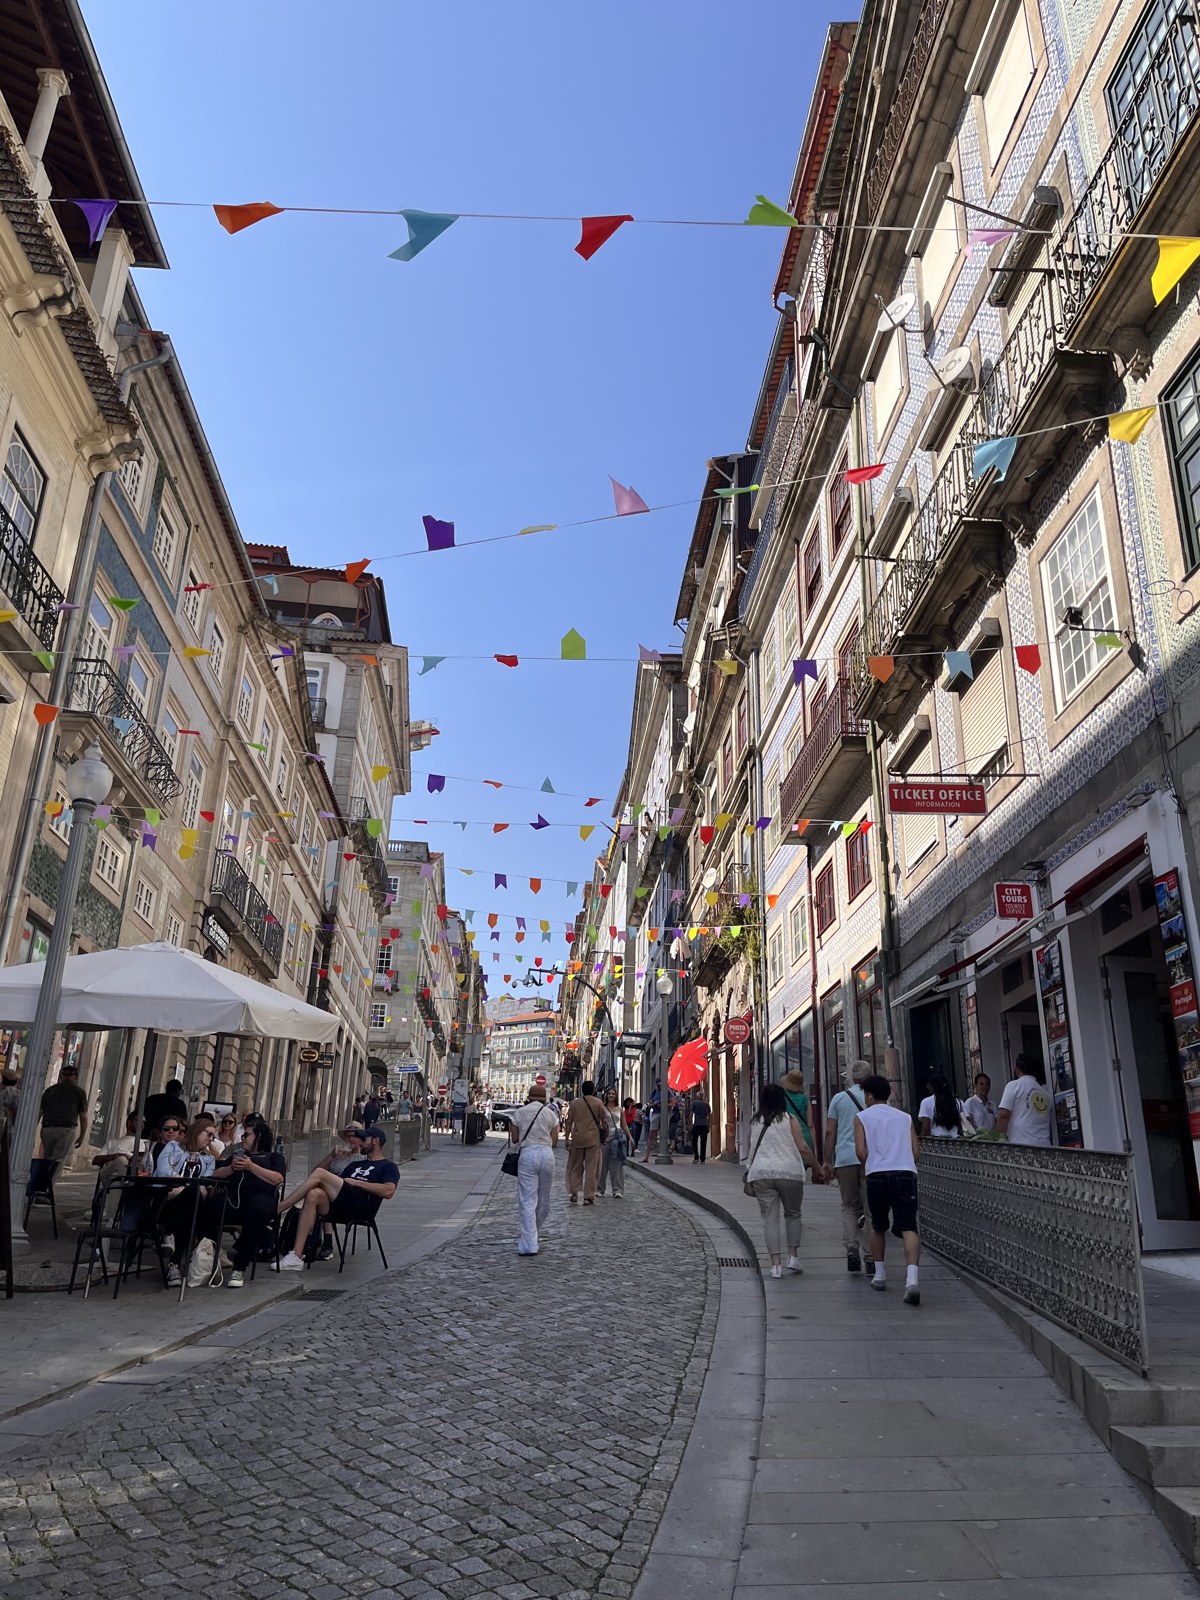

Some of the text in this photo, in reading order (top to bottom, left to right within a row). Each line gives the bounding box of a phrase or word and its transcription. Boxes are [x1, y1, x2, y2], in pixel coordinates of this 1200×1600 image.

[892, 788, 982, 801] TICKET OFFICE
[1001, 895, 1028, 903] TOURS
[1174, 992, 1193, 1006] Portugal
